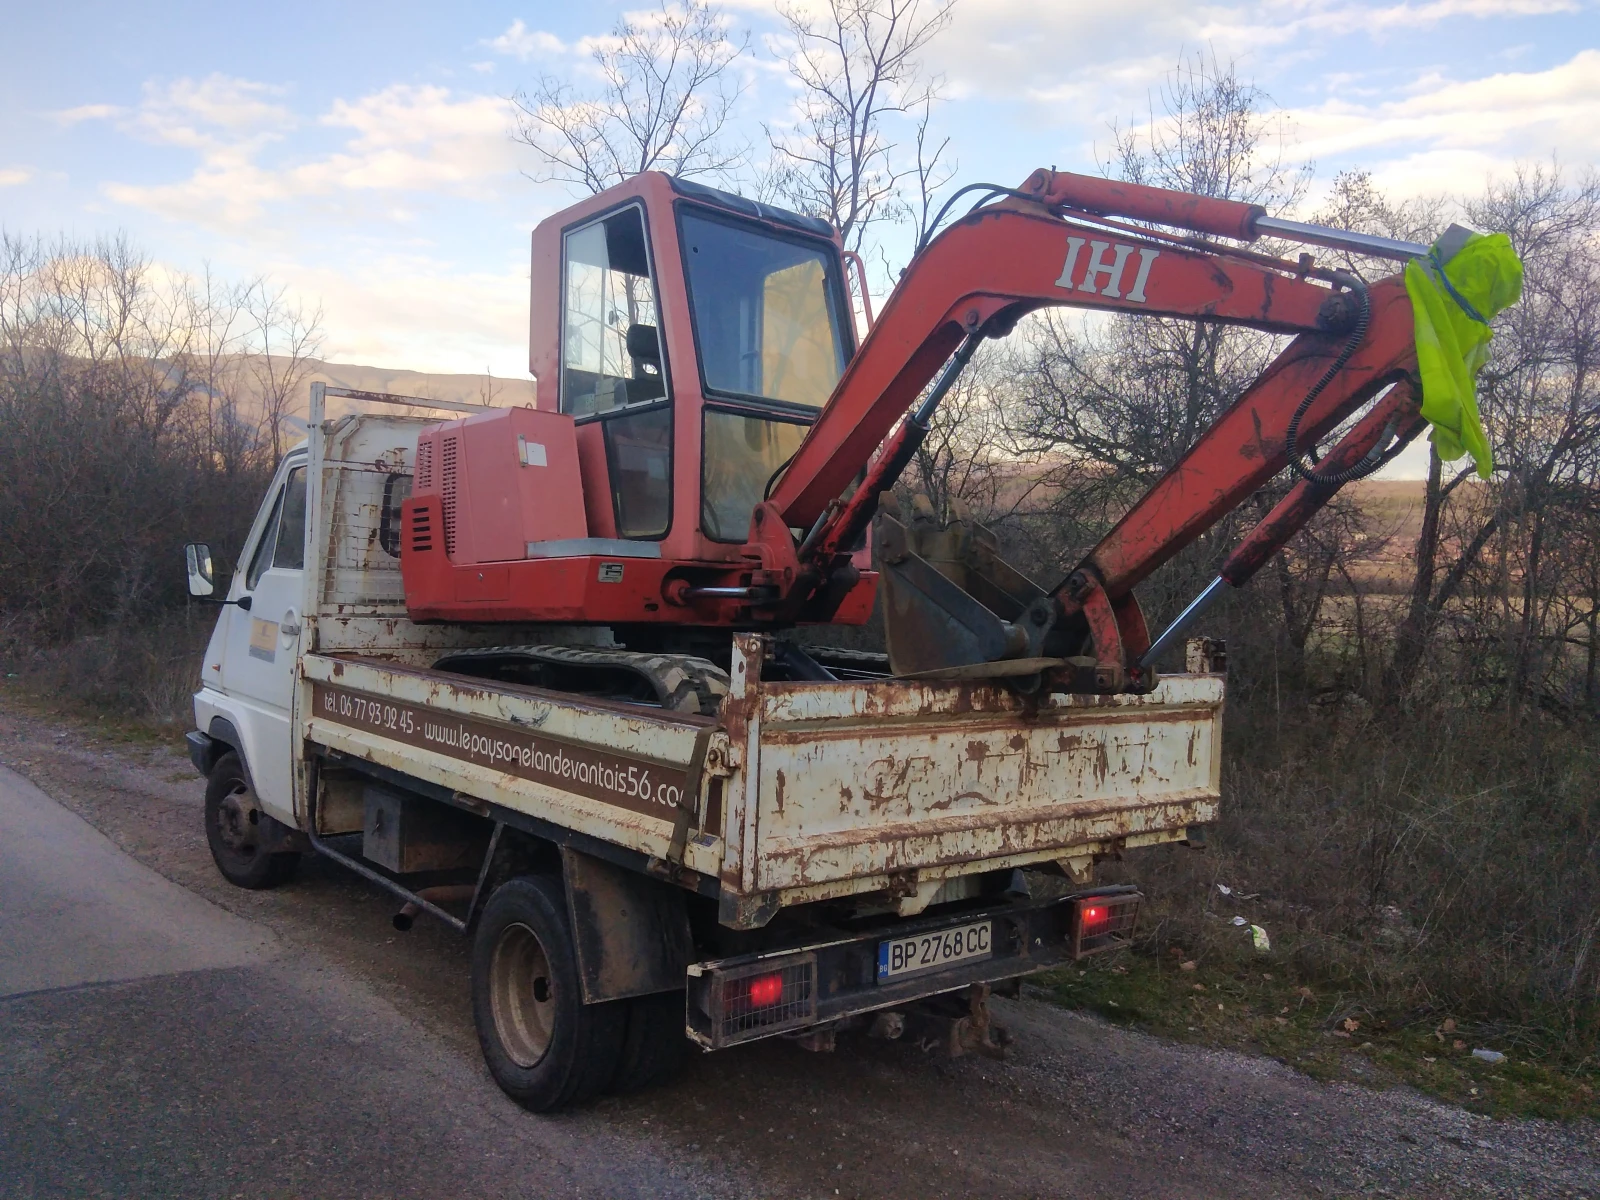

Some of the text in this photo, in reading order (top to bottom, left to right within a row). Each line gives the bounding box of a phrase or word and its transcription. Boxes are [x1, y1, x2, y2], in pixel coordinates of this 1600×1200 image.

[1054, 236, 1161, 303] IHI
[324, 692, 338, 713] tél.
[340, 695, 352, 717] 06
[354, 698, 367, 721] 77
[368, 702, 382, 725] 93
[383, 705, 397, 730] 02
[399, 709, 414, 734] 45
[424, 721, 697, 813] www.lepaysagelandevantais56.co
[879, 964, 888, 973] BG
[891, 925, 989, 971] BP 2768 CC
